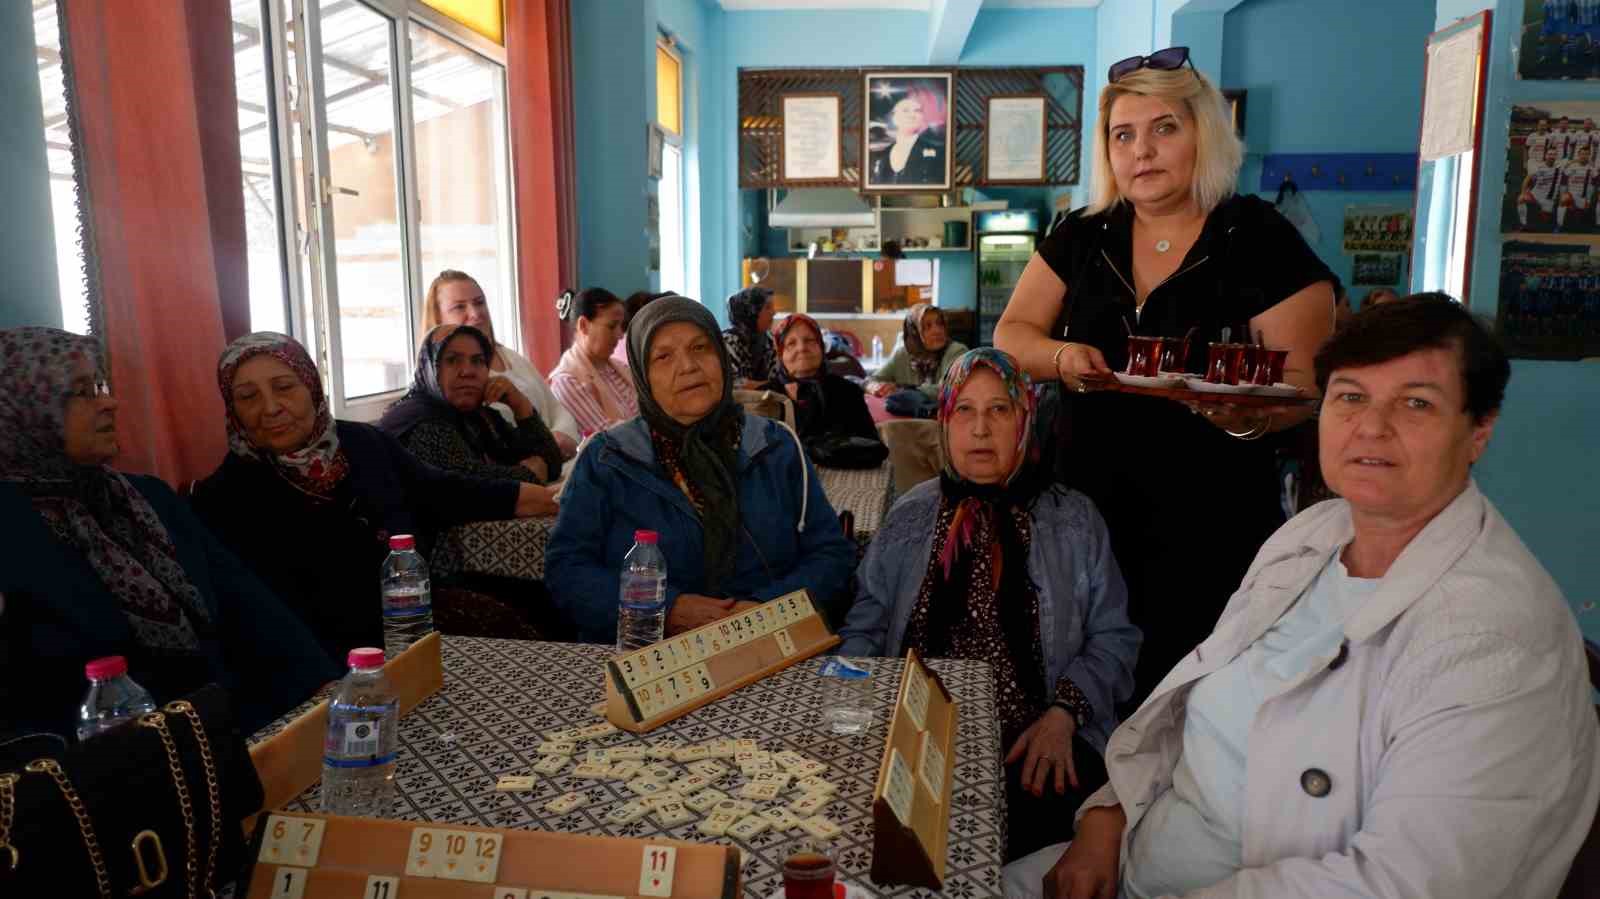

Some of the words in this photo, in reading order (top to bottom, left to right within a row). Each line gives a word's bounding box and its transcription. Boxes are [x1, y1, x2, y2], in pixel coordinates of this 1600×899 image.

[623, 660, 633, 673] 3
[653, 649, 663, 662] 2
[730, 619, 743, 633] 12
[743, 615, 752, 627] 9
[755, 610, 764, 622] 5
[788, 598, 796, 610] 5
[667, 676, 676, 690] 7
[272, 820, 286, 840] 6
[303, 822, 315, 842] 7
[419, 832, 432, 853] 9
[446, 834, 466, 855] 10
[475, 837, 497, 859] 12
[650, 850, 667, 872] 11
[284, 872, 292, 893] 1
[373, 881, 391, 899] 11
